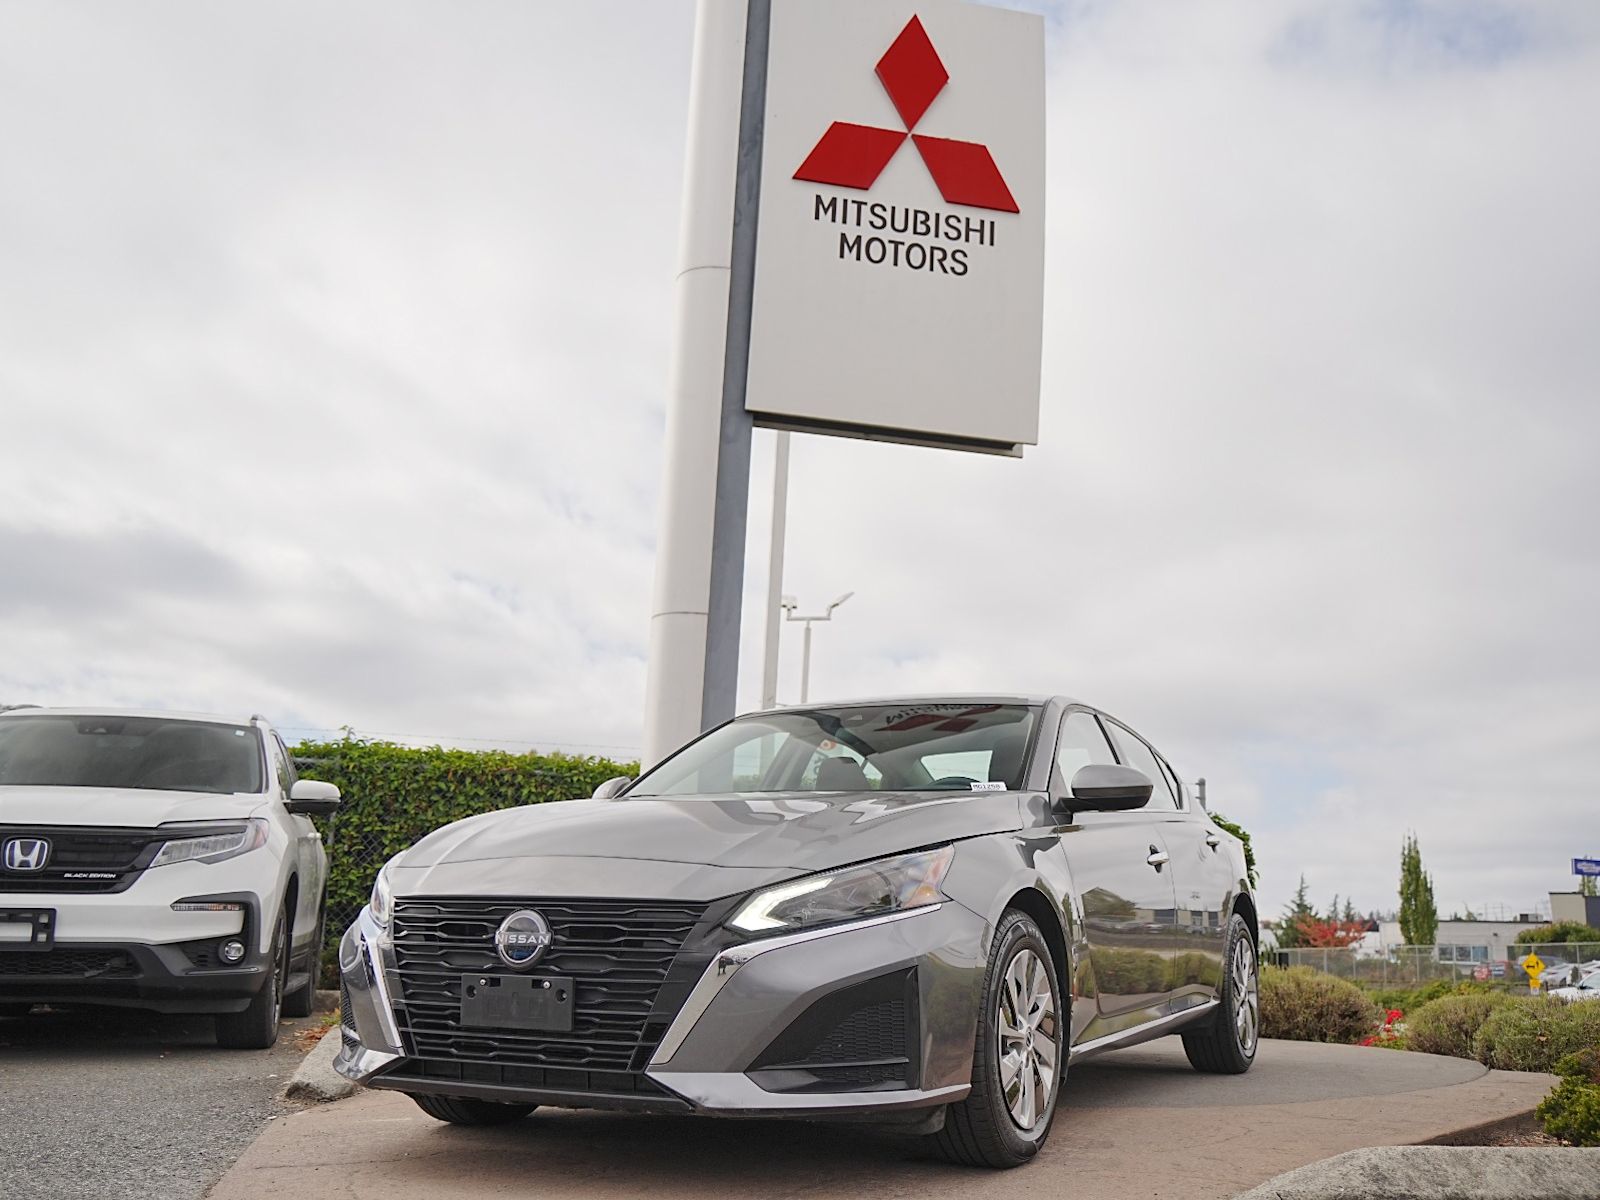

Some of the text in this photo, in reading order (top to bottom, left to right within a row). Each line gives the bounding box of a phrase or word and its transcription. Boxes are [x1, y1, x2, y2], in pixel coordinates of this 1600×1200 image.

[814, 194, 995, 246] MITSUBISHI
[839, 232, 968, 276] MOTORS
[495, 932, 549, 945] NISSAN
